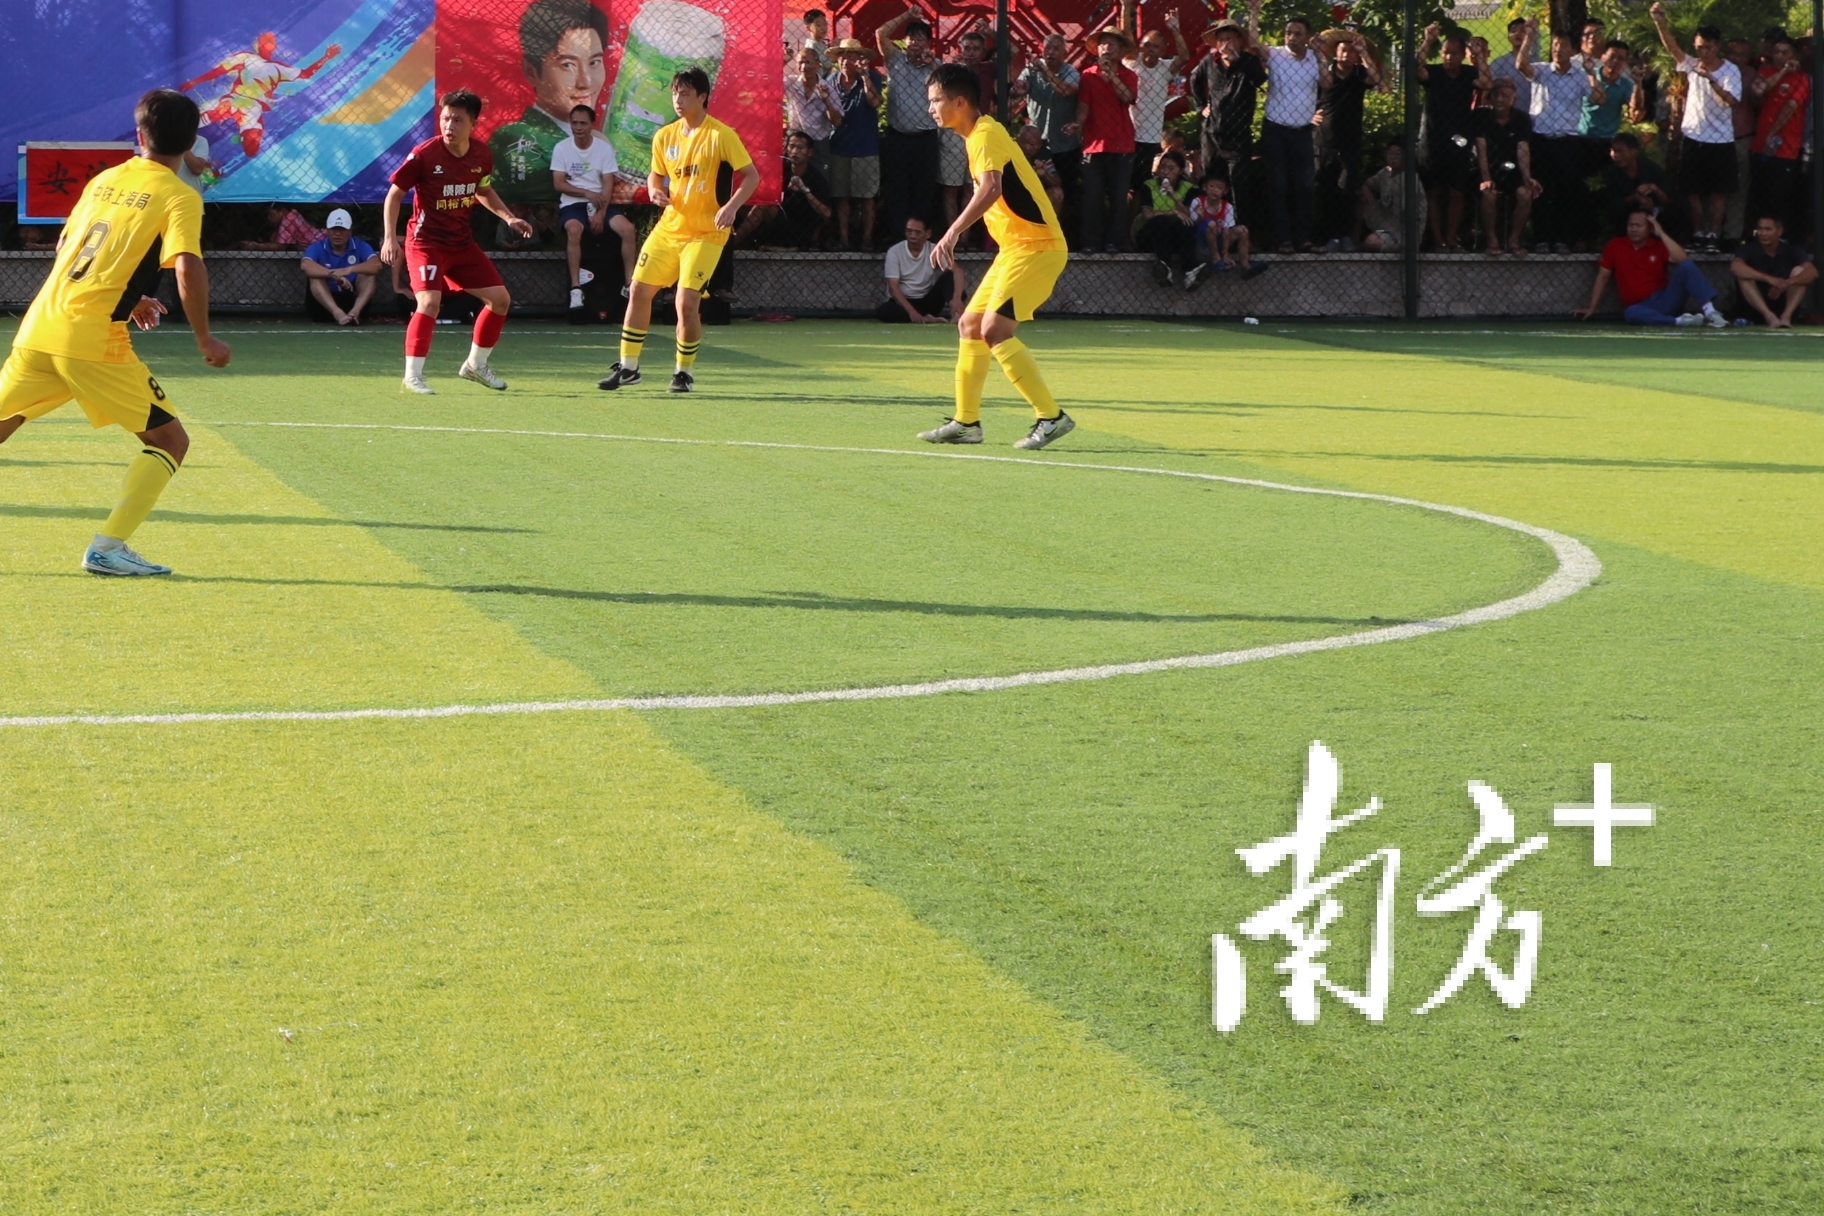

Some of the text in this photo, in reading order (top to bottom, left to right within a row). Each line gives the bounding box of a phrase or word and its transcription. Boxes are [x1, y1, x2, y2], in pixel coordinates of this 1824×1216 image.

[93, 185, 152, 211] 中铁上海局
[66, 219, 112, 284] 8
[419, 265, 437, 281] 17
[148, 377, 165, 401] 8
